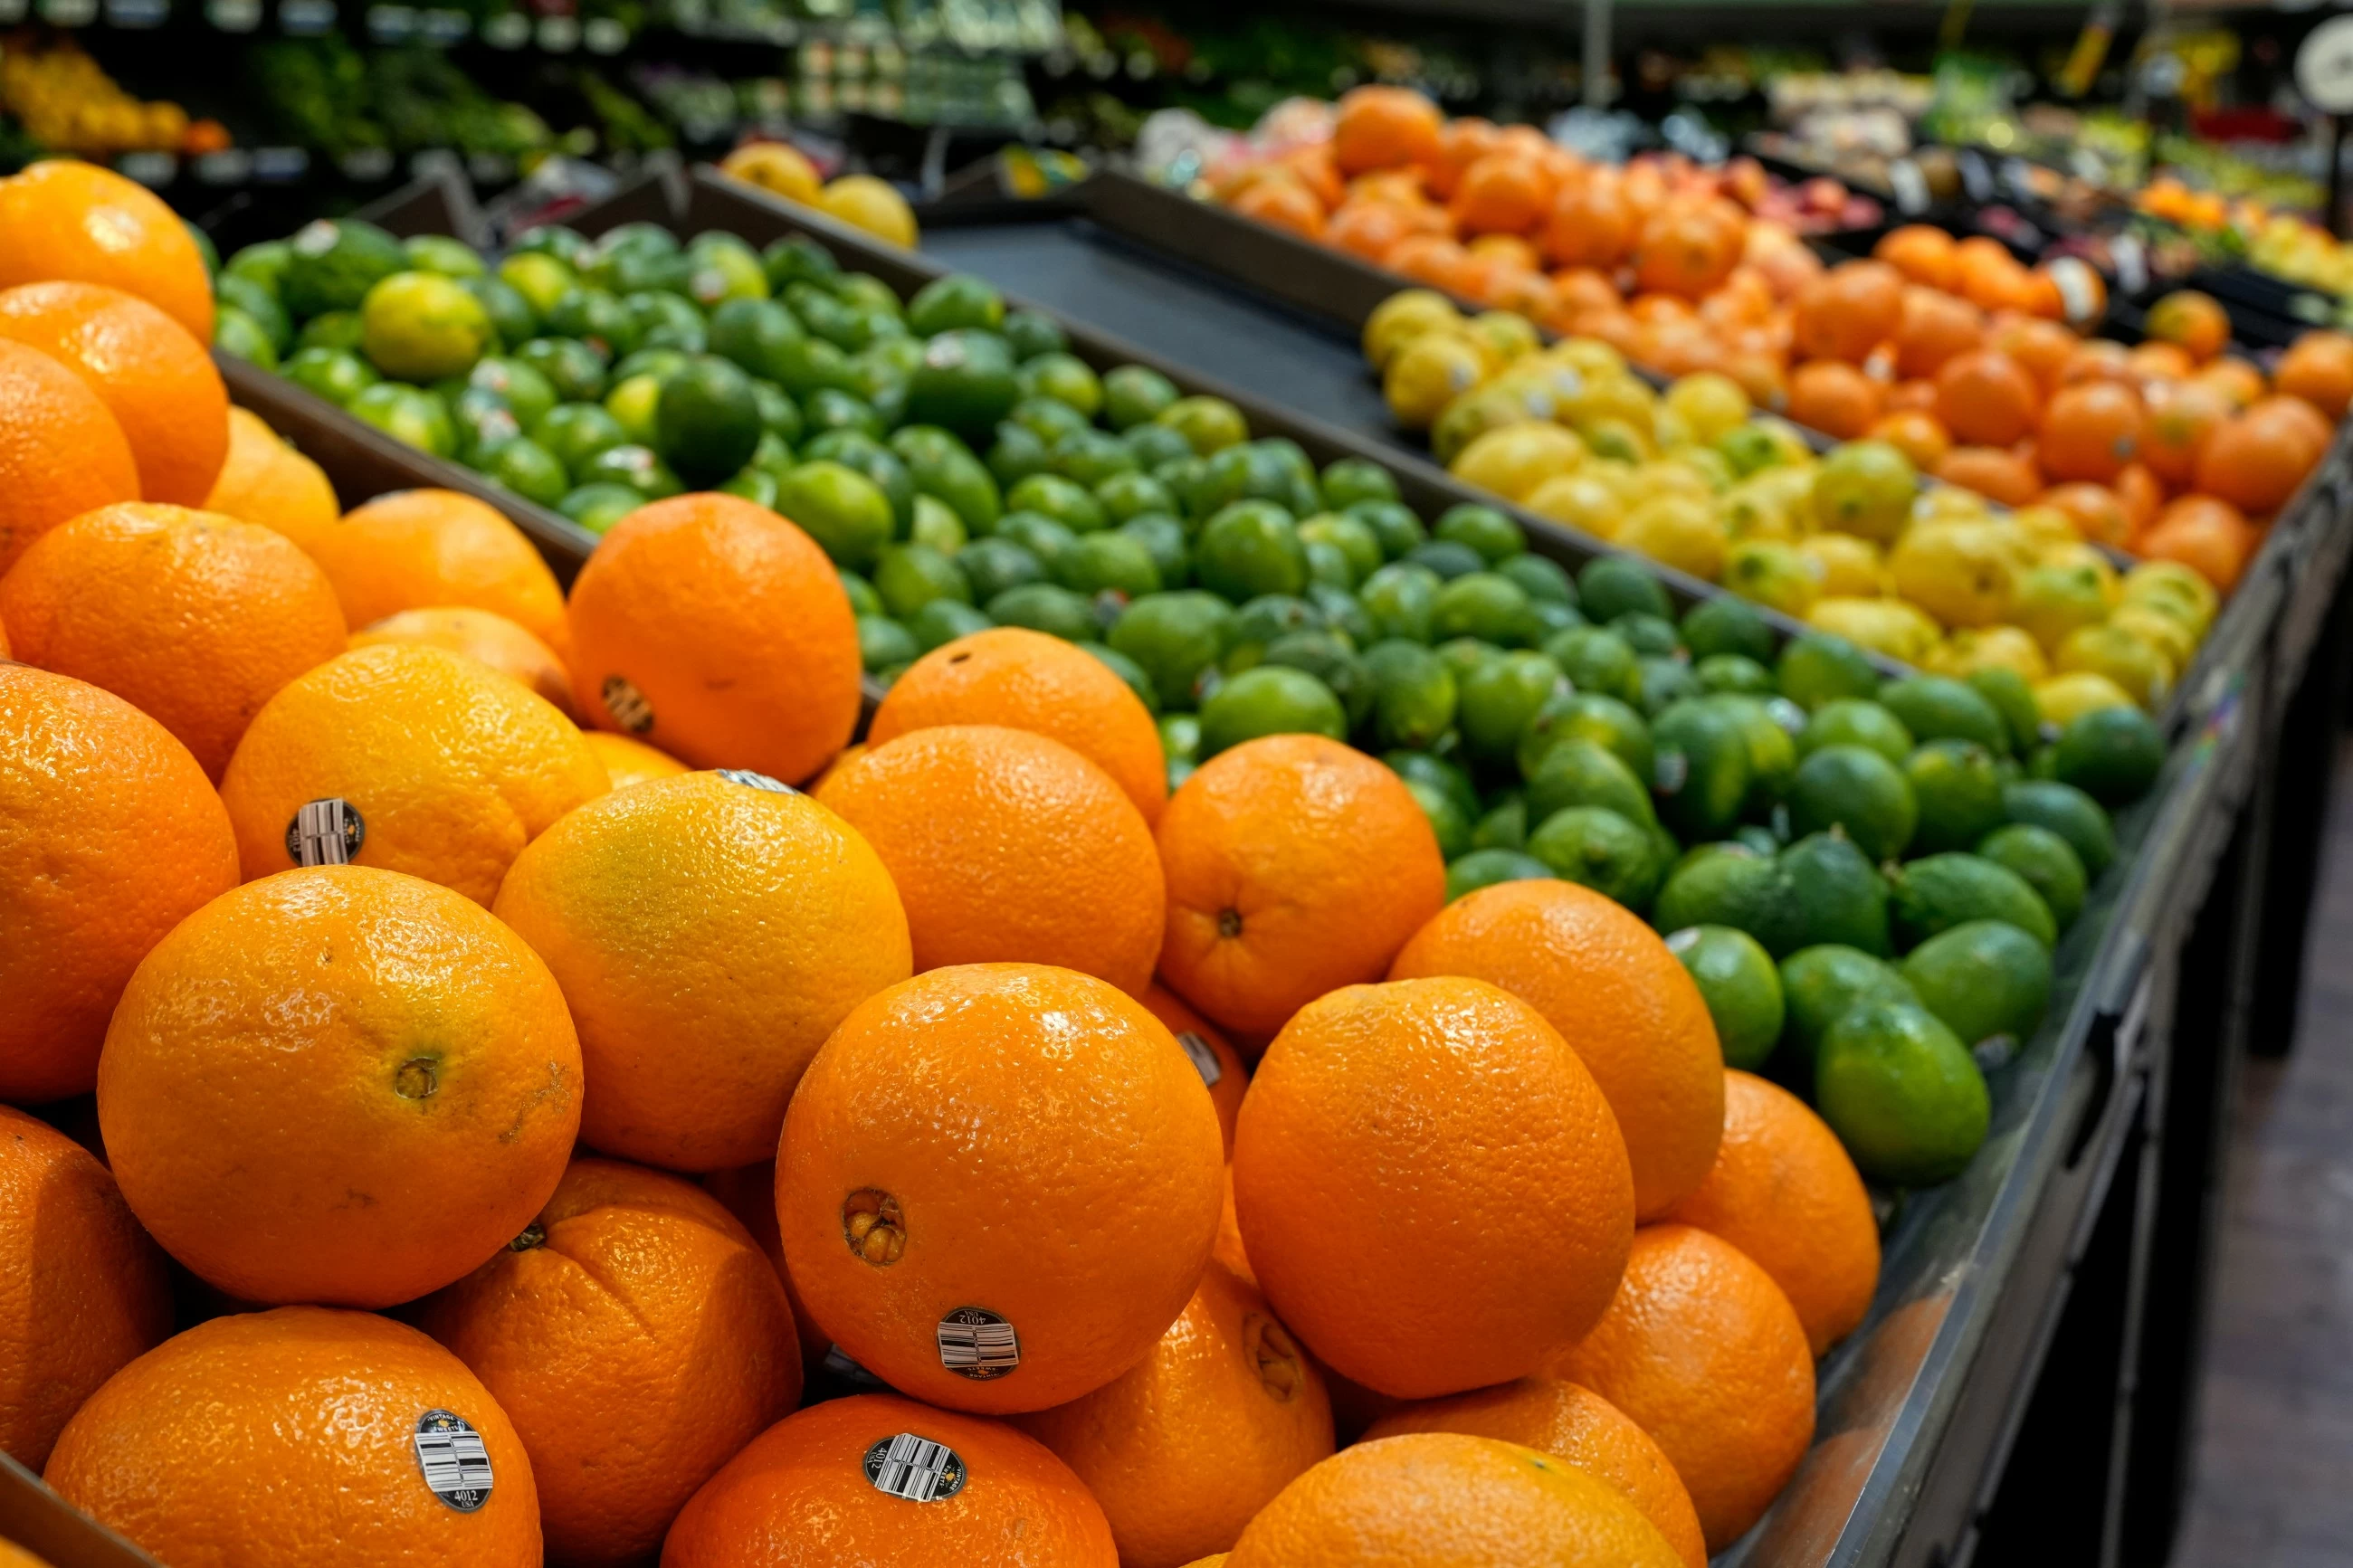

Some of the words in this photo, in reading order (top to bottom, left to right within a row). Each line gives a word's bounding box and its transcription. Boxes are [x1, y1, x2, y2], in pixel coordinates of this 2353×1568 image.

[958, 1315, 986, 1325] 4012
[428, 1413, 455, 1421] VINTAGE
[871, 1447, 888, 1469] 4012
[948, 1467, 962, 1491] VINTAGE
[454, 1489, 478, 1502] 4012
